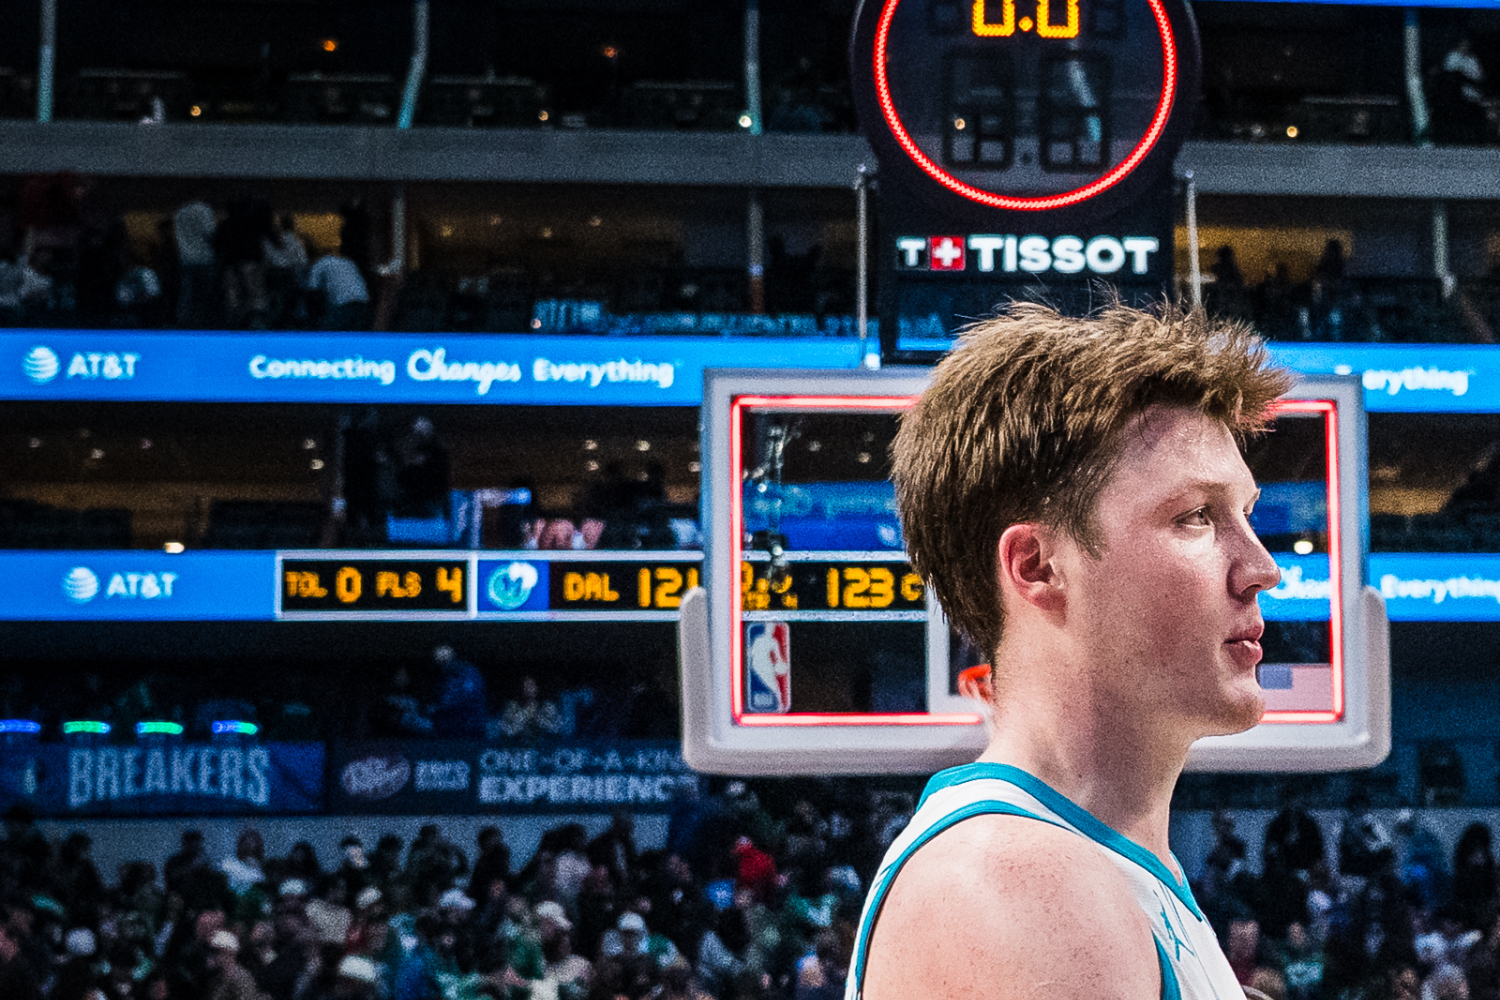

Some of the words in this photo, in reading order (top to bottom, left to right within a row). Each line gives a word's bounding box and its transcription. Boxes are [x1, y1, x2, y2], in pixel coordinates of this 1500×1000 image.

[968, 235, 1159, 274] TISSOT
[67, 353, 138, 379] AT&T
[248, 355, 396, 385] Connecting
[407, 348, 522, 395] Changes
[533, 357, 675, 389] Everything
[107, 572, 176, 599] AT&T
[336, 566, 363, 603] 0
[436, 566, 463, 603] 4
[564, 571, 620, 602] DAL
[826, 567, 895, 608] 123
[70, 747, 271, 806] BREAKERS
